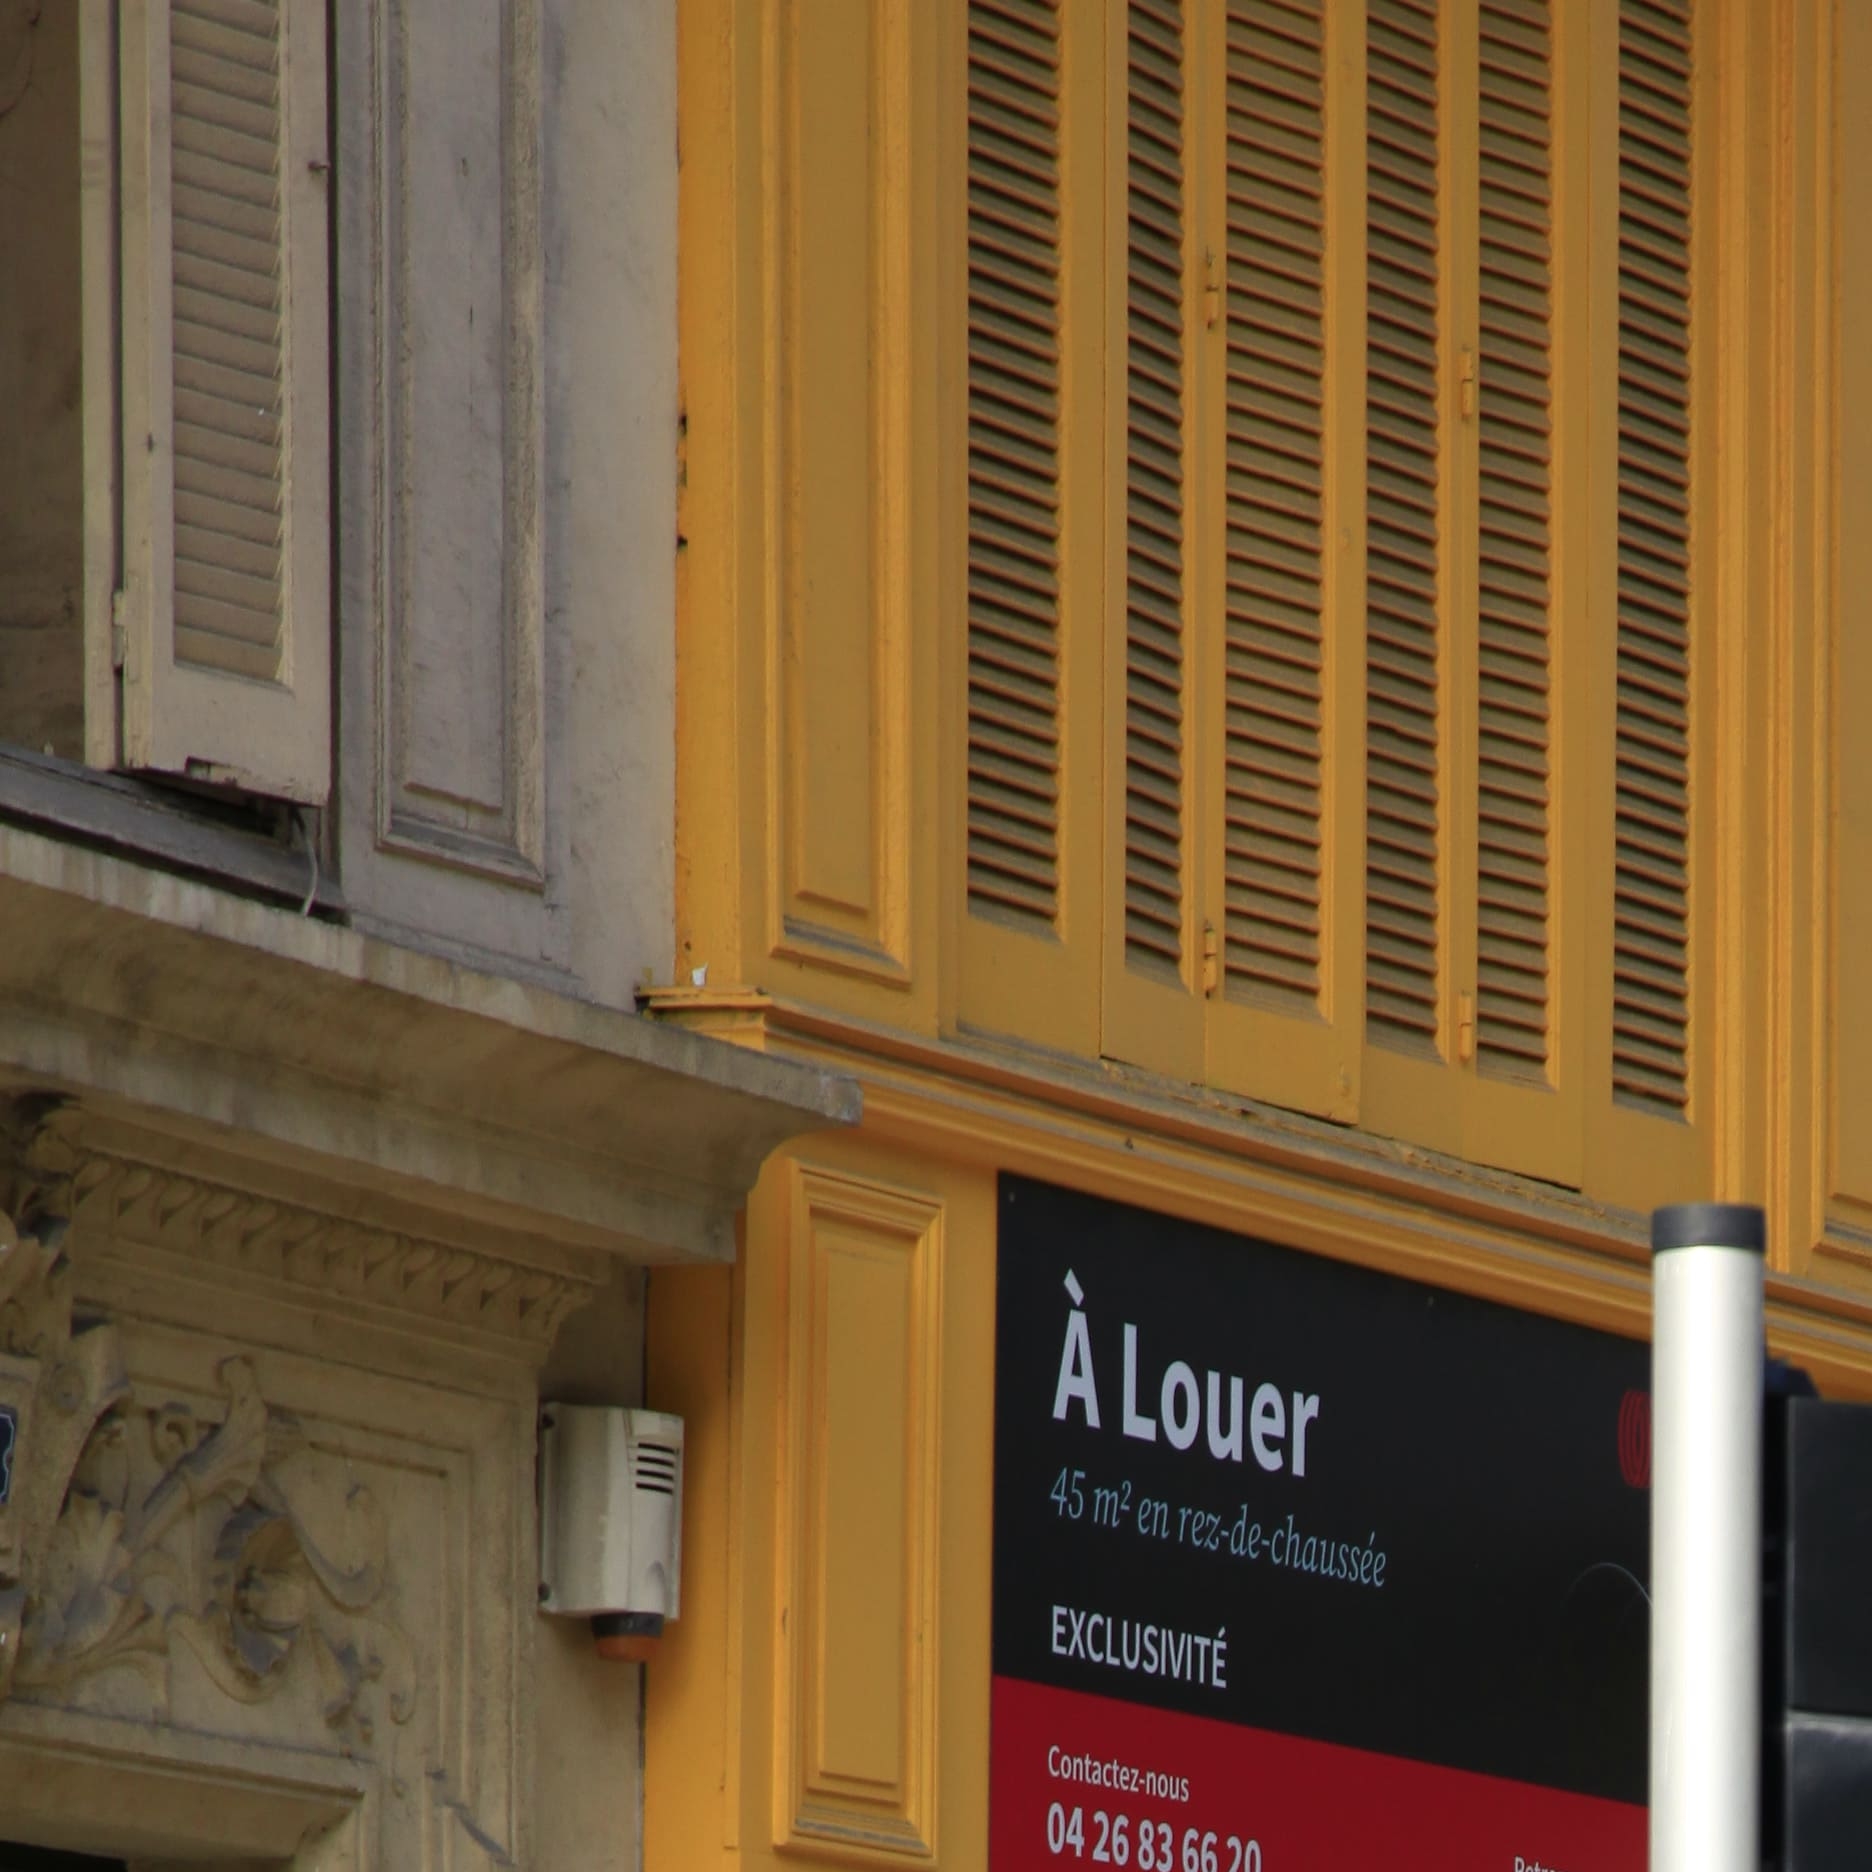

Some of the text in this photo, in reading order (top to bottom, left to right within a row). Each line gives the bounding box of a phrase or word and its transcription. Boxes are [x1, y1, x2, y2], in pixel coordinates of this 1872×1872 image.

[1053, 1268, 1320, 1478] À Louer
[1050, 1466, 1388, 1589] 45 m² en rez-de-chaussée
[1051, 1604, 1228, 1690] EXCLUSIVITÉ
[1047, 1745, 1191, 1804] Contactez-nous
[1046, 1802, 1084, 1858] 04
[1092, 1811, 1130, 1865] 26
